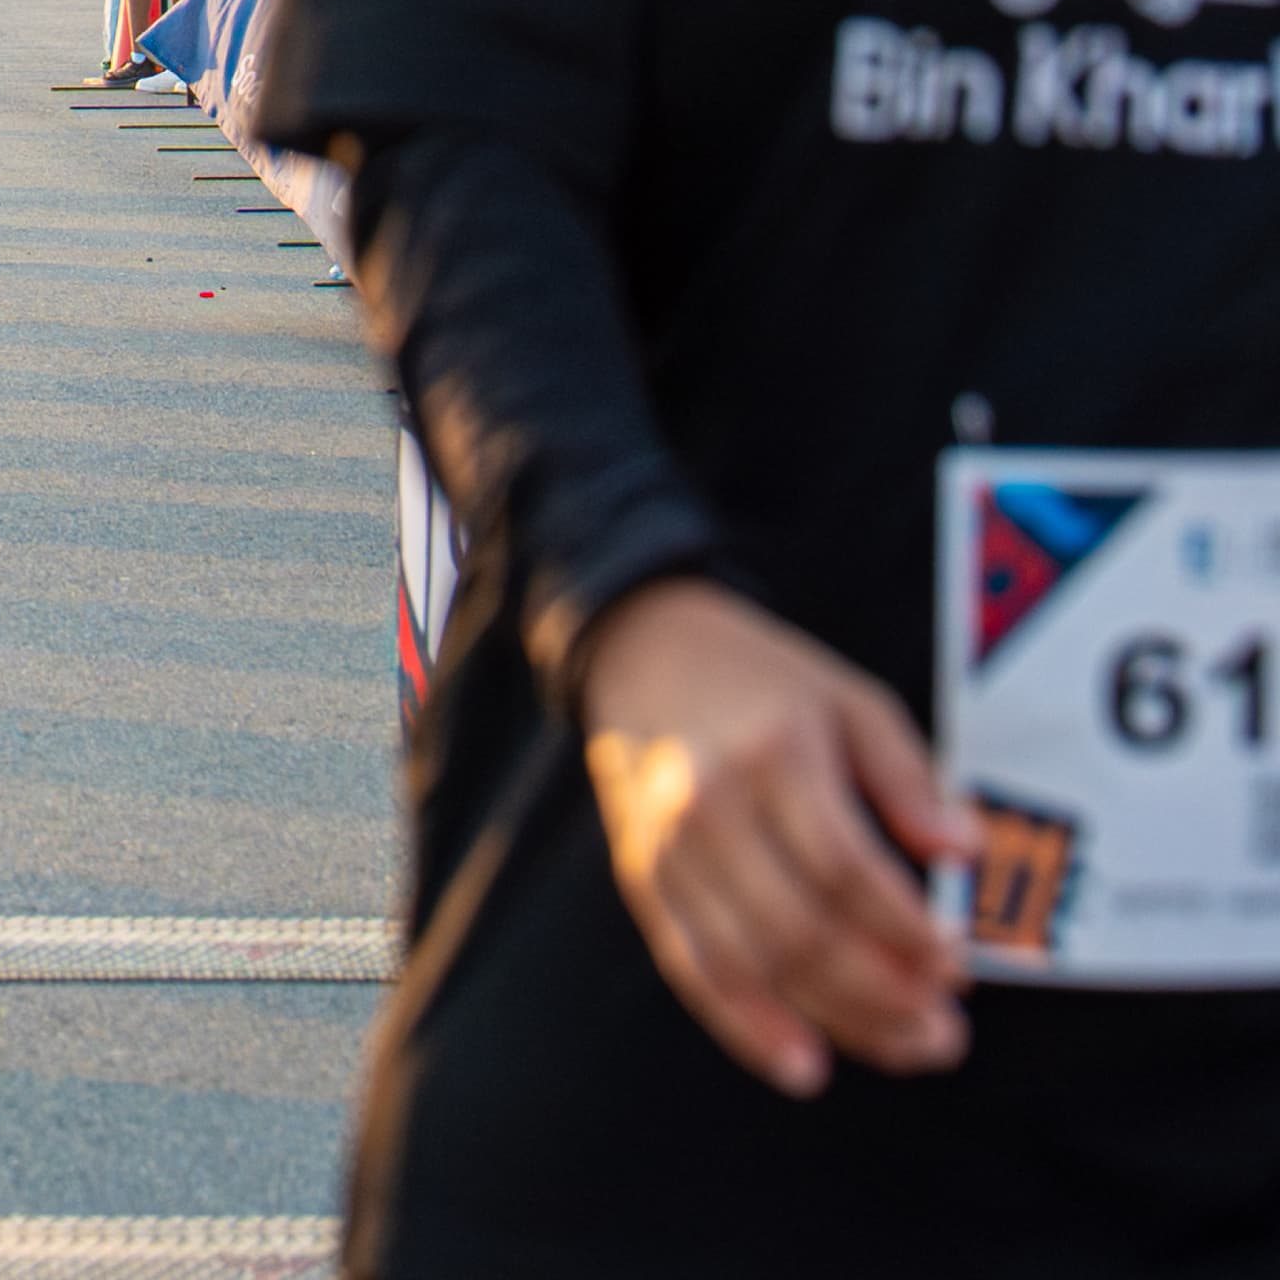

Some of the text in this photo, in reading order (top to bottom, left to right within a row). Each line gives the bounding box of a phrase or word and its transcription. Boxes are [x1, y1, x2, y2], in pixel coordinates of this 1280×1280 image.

[831, 16, 1280, 158] Bin Khar
[1104, 628, 1270, 756] 61
